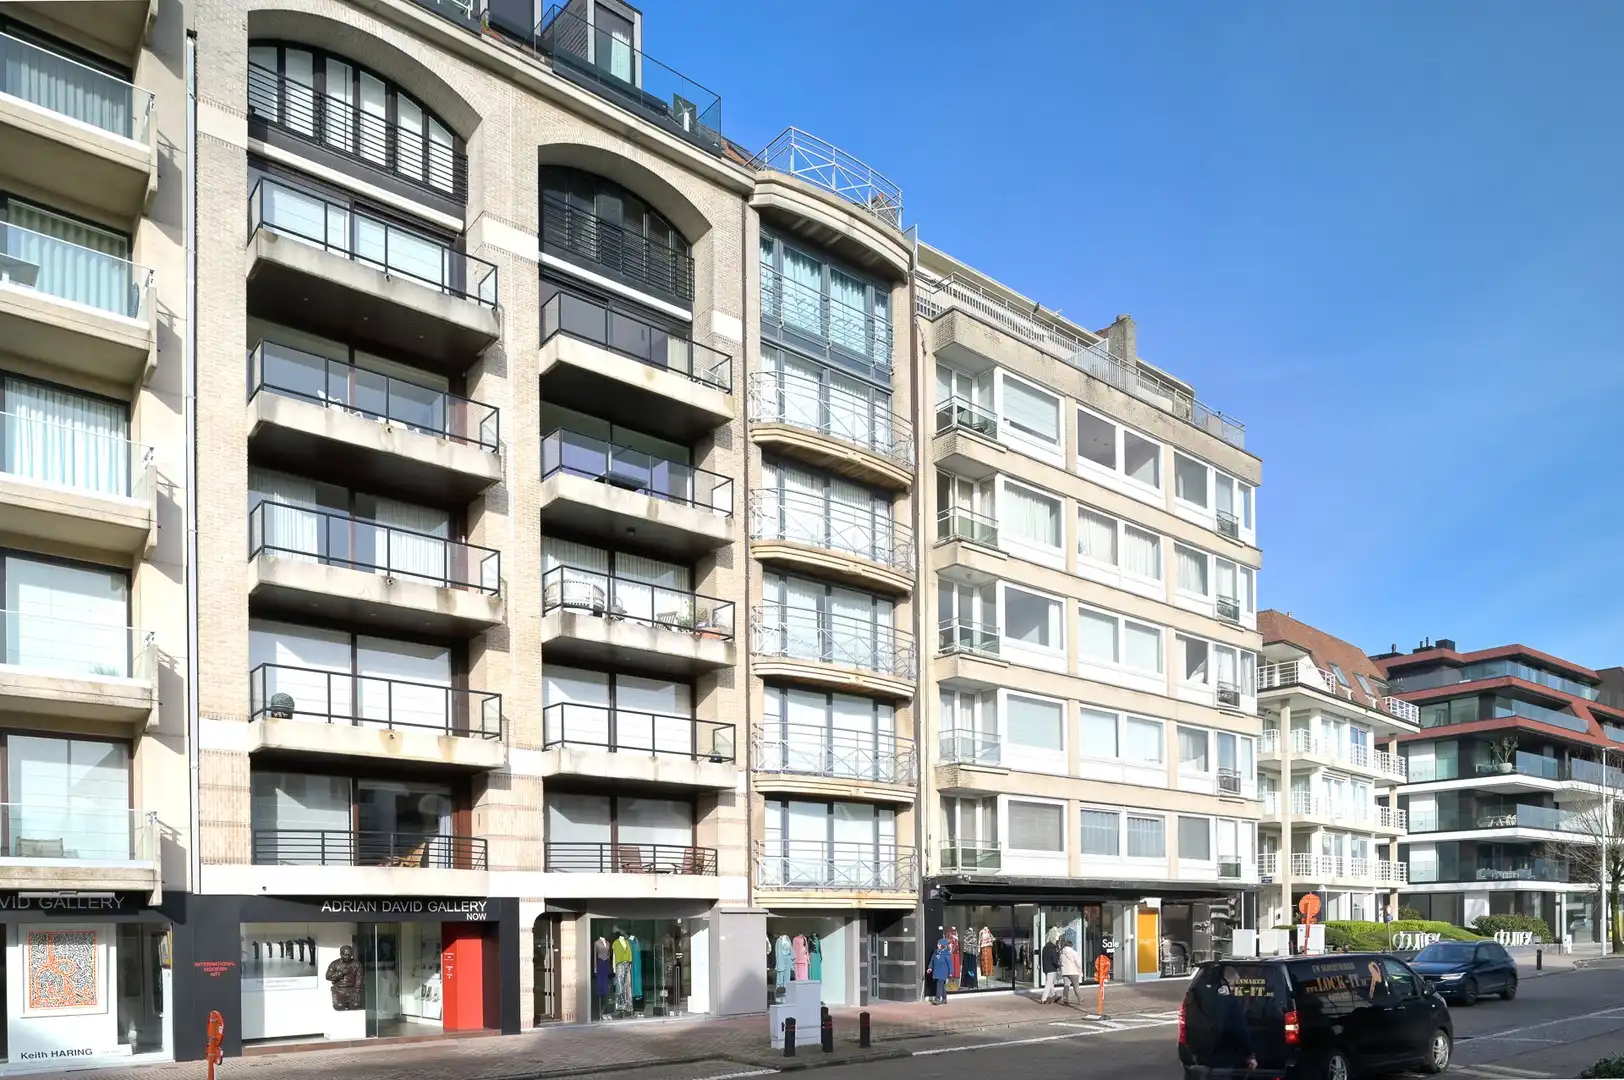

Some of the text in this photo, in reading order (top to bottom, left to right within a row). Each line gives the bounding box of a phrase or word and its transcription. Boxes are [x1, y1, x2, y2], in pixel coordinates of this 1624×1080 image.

[39, 896, 125, 909] GALLERY
[321, 900, 487, 912] ADRIAN DAVID GALLERY
[1102, 938, 1120, 948] Sale
[20, 1051, 48, 1060] Keith
[51, 1048, 93, 1058] HARING
